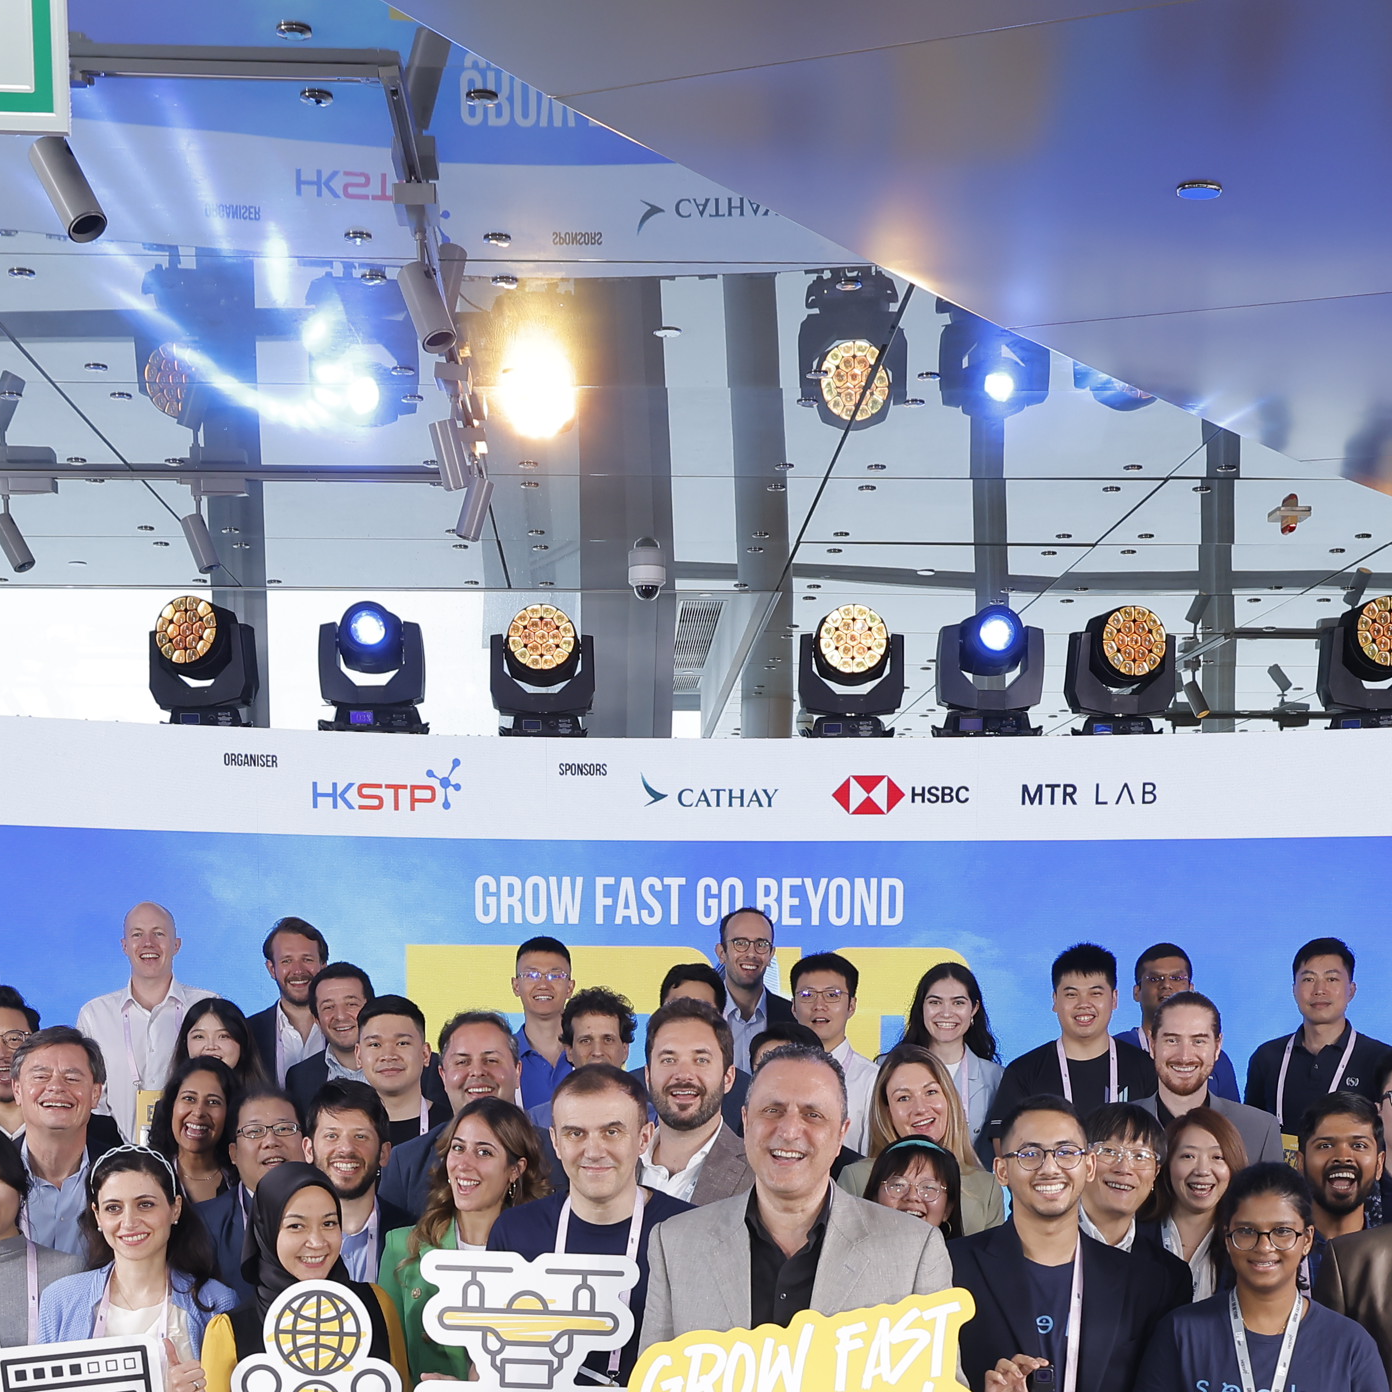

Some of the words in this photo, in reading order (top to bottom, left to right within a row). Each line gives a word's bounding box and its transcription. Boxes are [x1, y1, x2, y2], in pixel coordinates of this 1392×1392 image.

[223, 752, 278, 768] ORGANISER
[558, 762, 608, 776] SPONSORS
[311, 781, 437, 812] HKSTP
[676, 788, 780, 808] CATHAY
[910, 786, 970, 804] HSBC
[1020, 783, 1078, 806] MTR
[1094, 782, 1158, 806] LAB
[474, 874, 584, 925] GROW
[594, 875, 687, 926] FAST
[696, 876, 745, 926] GO
[757, 876, 905, 927] BEYOND
[834, 1300, 962, 1392] FAST
